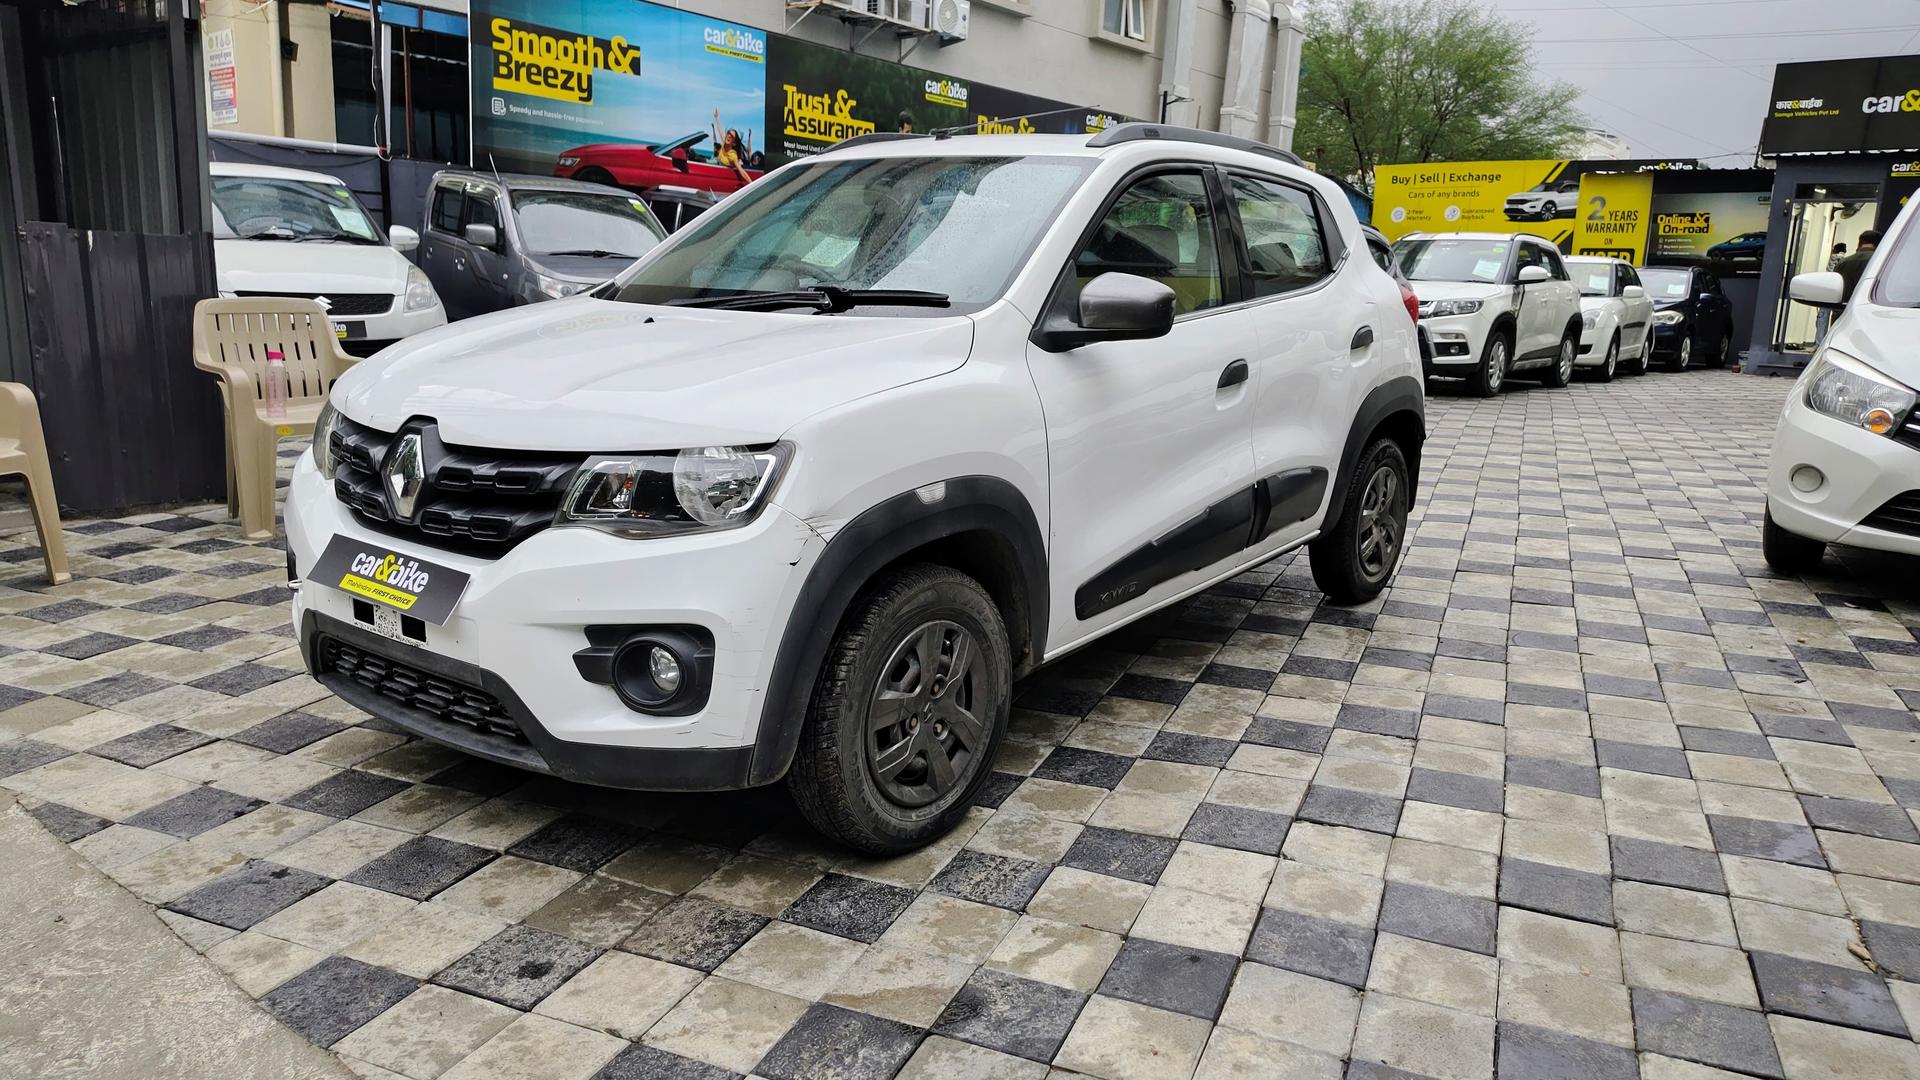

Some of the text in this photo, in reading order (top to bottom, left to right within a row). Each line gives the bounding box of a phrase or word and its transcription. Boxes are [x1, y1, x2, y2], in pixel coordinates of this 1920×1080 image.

[491, 18, 641, 76] Smooth &
[704, 27, 764, 54] car&bike
[494, 51, 593, 103] Breezy
[925, 79, 968, 100] car&bike
[783, 84, 857, 119] Trust &
[1391, 175, 1411, 186] Buy
[1419, 173, 1440, 183] Sell
[1449, 172, 1502, 183] Exchange
[1408, 191, 1425, 199] Cars
[1427, 190, 1435, 198] of
[1452, 190, 1480, 198] brands
[1587, 196, 1639, 222] 2 YEARS
[1657, 211, 1711, 226] Online &
[1585, 222, 1637, 234] WARRANTY
[1663, 223, 1710, 234] On-road
[1604, 237, 1613, 246] ON
[351, 552, 429, 593] car&bike
[372, 588, 390, 598] FIRST
[389, 593, 412, 606] CHOICE
